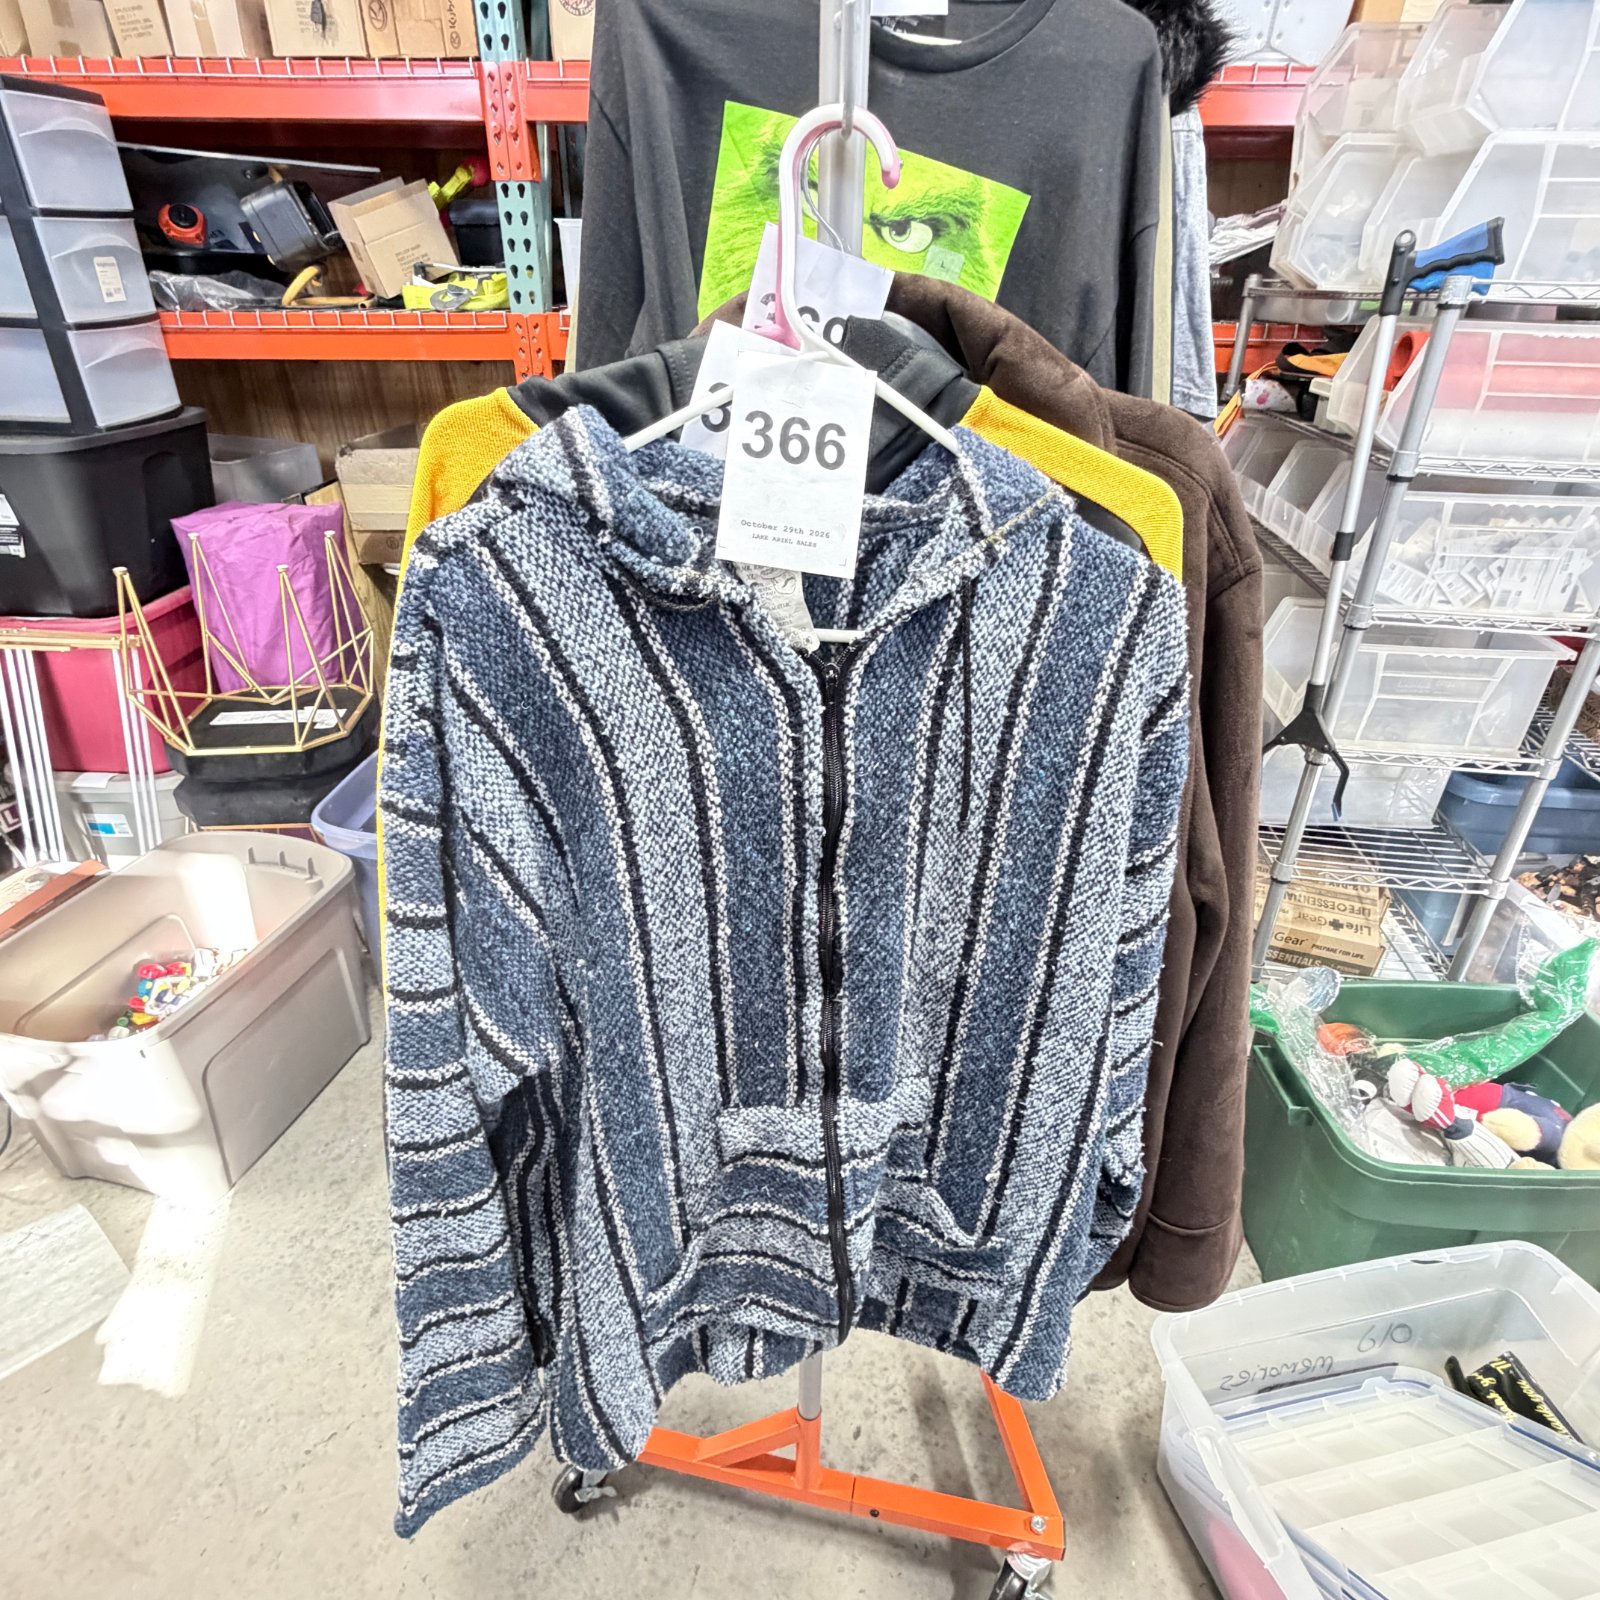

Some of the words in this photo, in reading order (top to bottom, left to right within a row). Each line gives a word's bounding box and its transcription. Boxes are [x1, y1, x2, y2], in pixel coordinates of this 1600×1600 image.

[742, 410, 846, 471] 366
[740, 519, 778, 531] October
[783, 525, 804, 535] 29th
[809, 529, 830, 539] 2026
[752, 533, 769, 541] LAKE
[772, 537, 793, 545] ARIEL
[796, 540, 817, 548] SALES
[1296, 911, 1327, 926] Gear
[1346, 922, 1371, 936] Life
[1274, 932, 1307, 946] Gear
[1311, 943, 1337, 955] PREPARE
[1339, 949, 1351, 957] FOR
